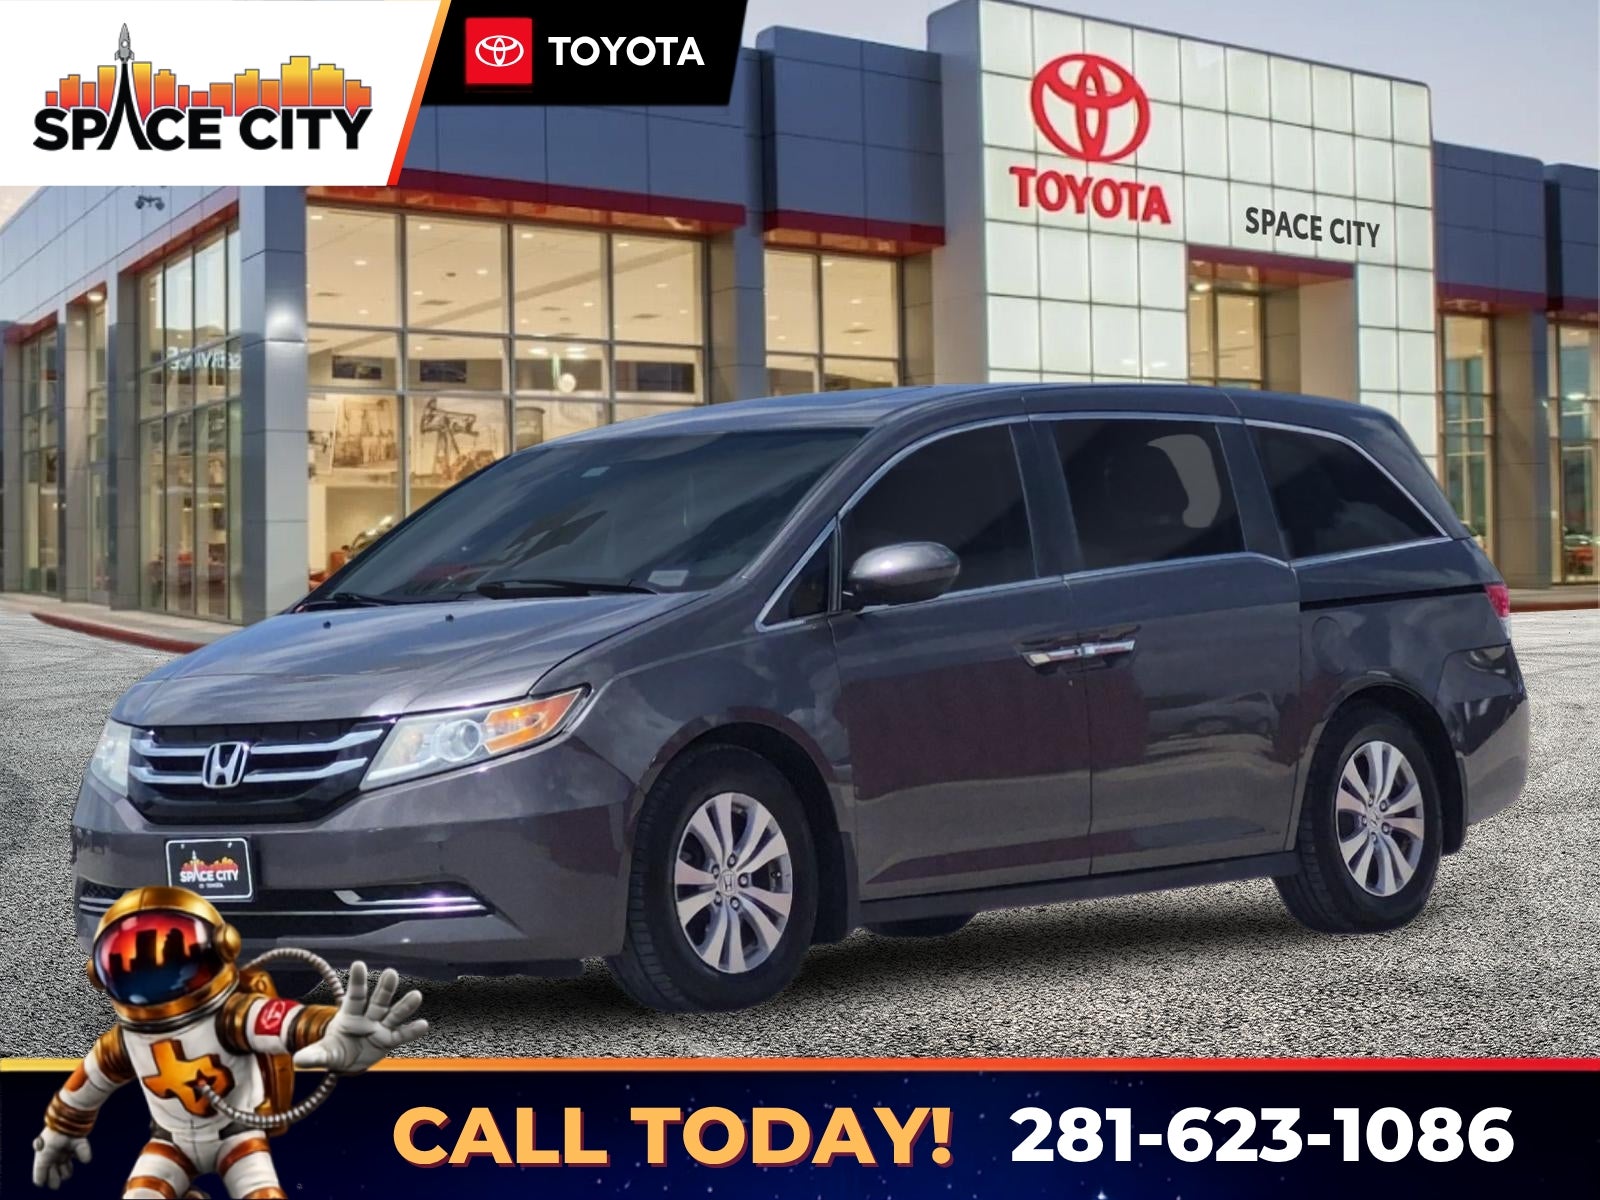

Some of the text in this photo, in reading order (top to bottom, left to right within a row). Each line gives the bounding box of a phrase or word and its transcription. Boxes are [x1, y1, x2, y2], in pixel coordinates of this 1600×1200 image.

[1009, 166, 1172, 225] TOYOTA
[1245, 206, 1381, 248] SPACE CITY
[180, 868, 239, 883] SPACE CITY
